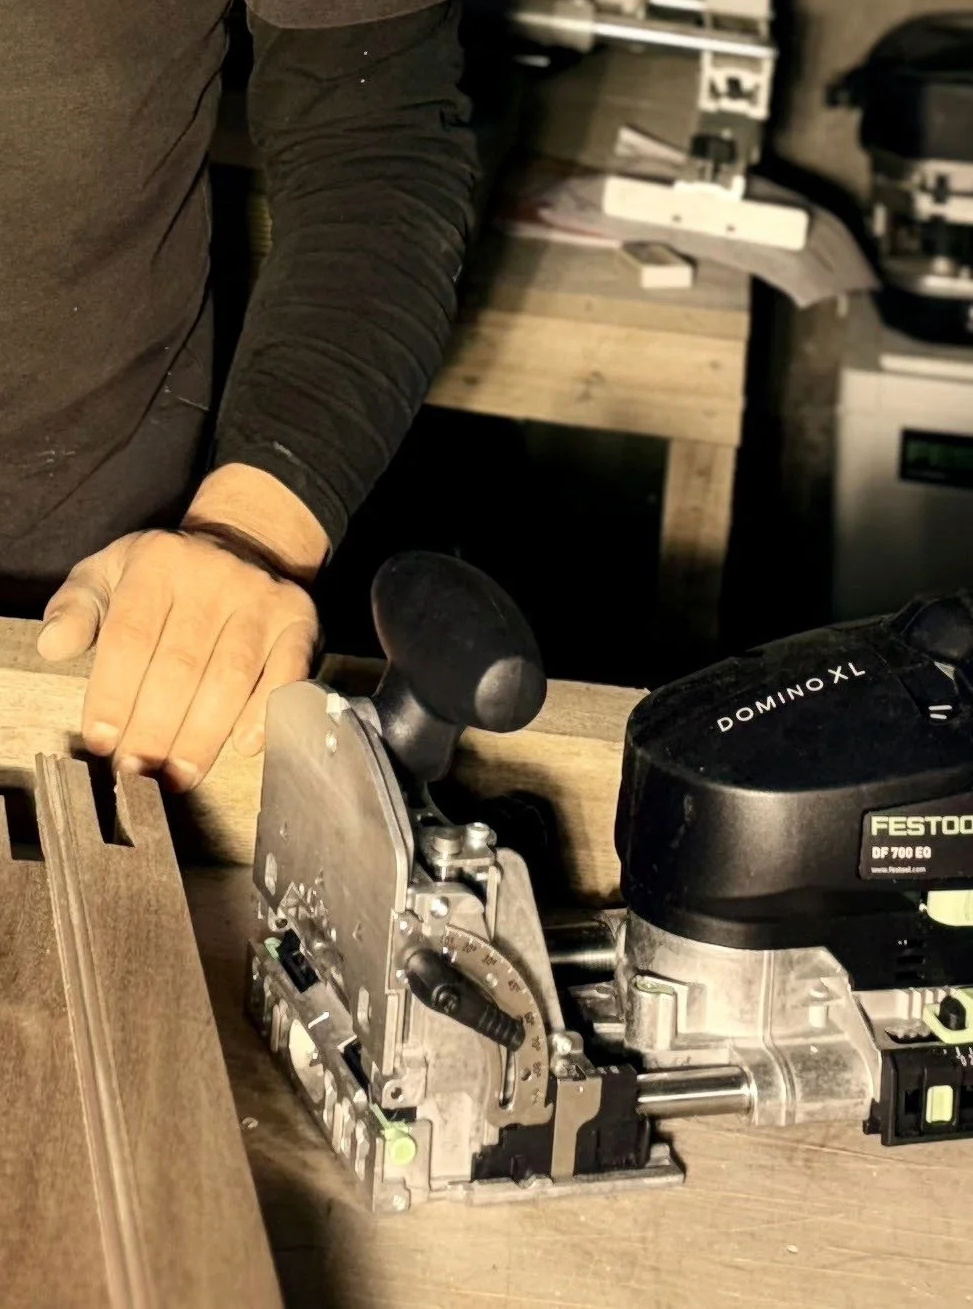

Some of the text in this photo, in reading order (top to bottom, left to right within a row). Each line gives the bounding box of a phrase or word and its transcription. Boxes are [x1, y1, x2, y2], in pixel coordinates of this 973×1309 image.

[717, 662, 866, 732] DOMINO XL
[872, 846, 932, 859] DF 700 EQ
